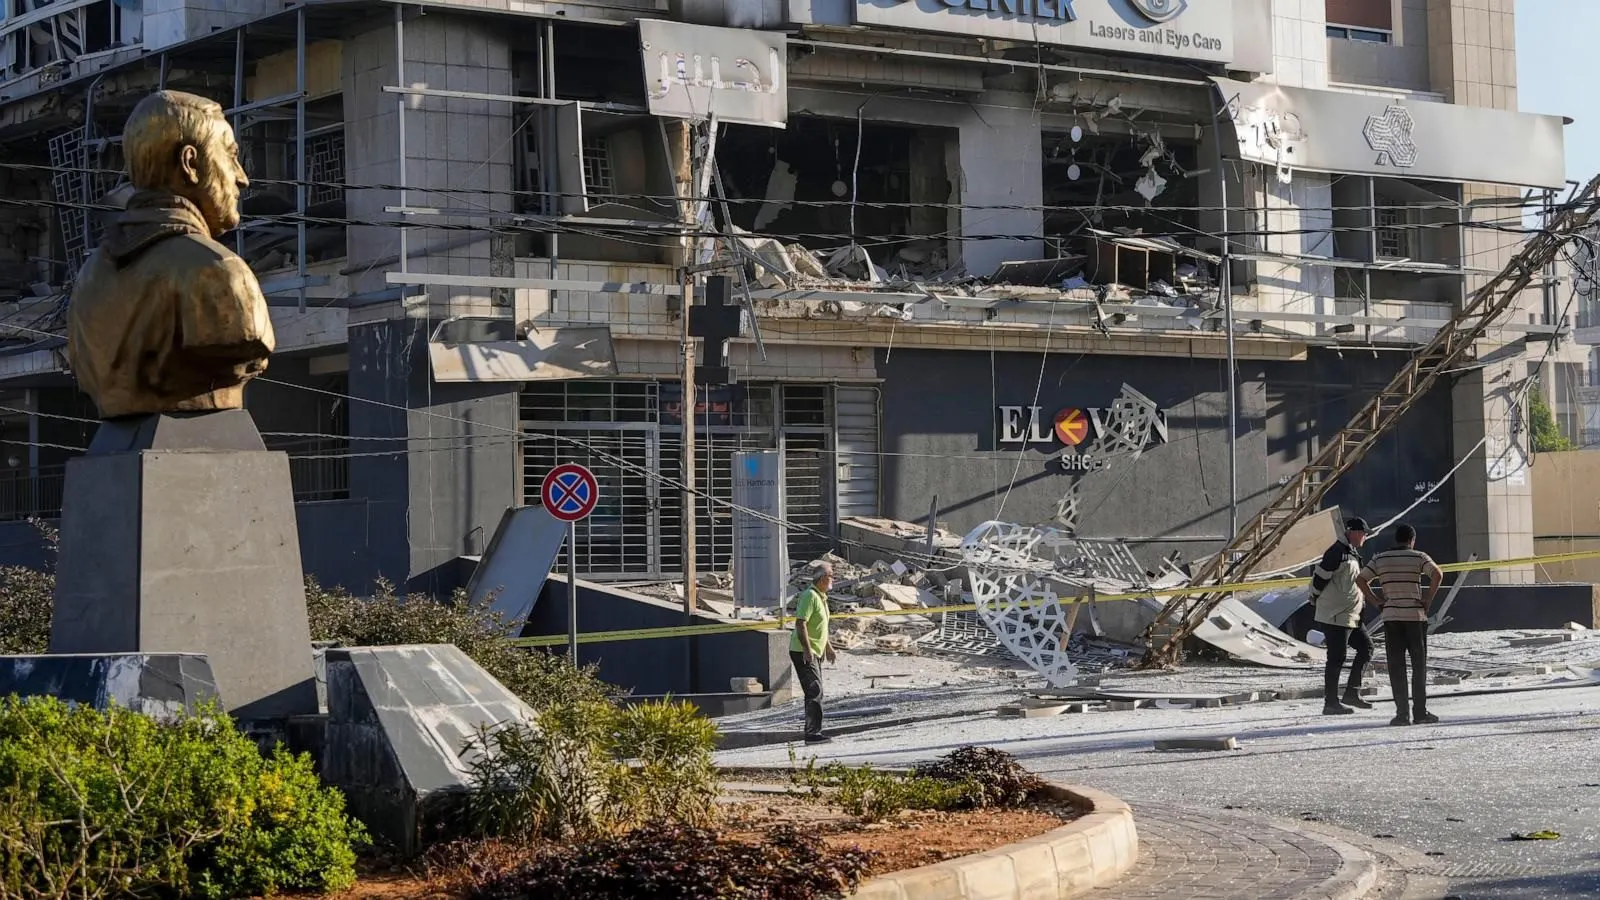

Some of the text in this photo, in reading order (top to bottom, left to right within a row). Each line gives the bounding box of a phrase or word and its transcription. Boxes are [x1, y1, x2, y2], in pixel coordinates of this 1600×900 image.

[1089, 20, 1222, 50] Lasers and Eye Care
